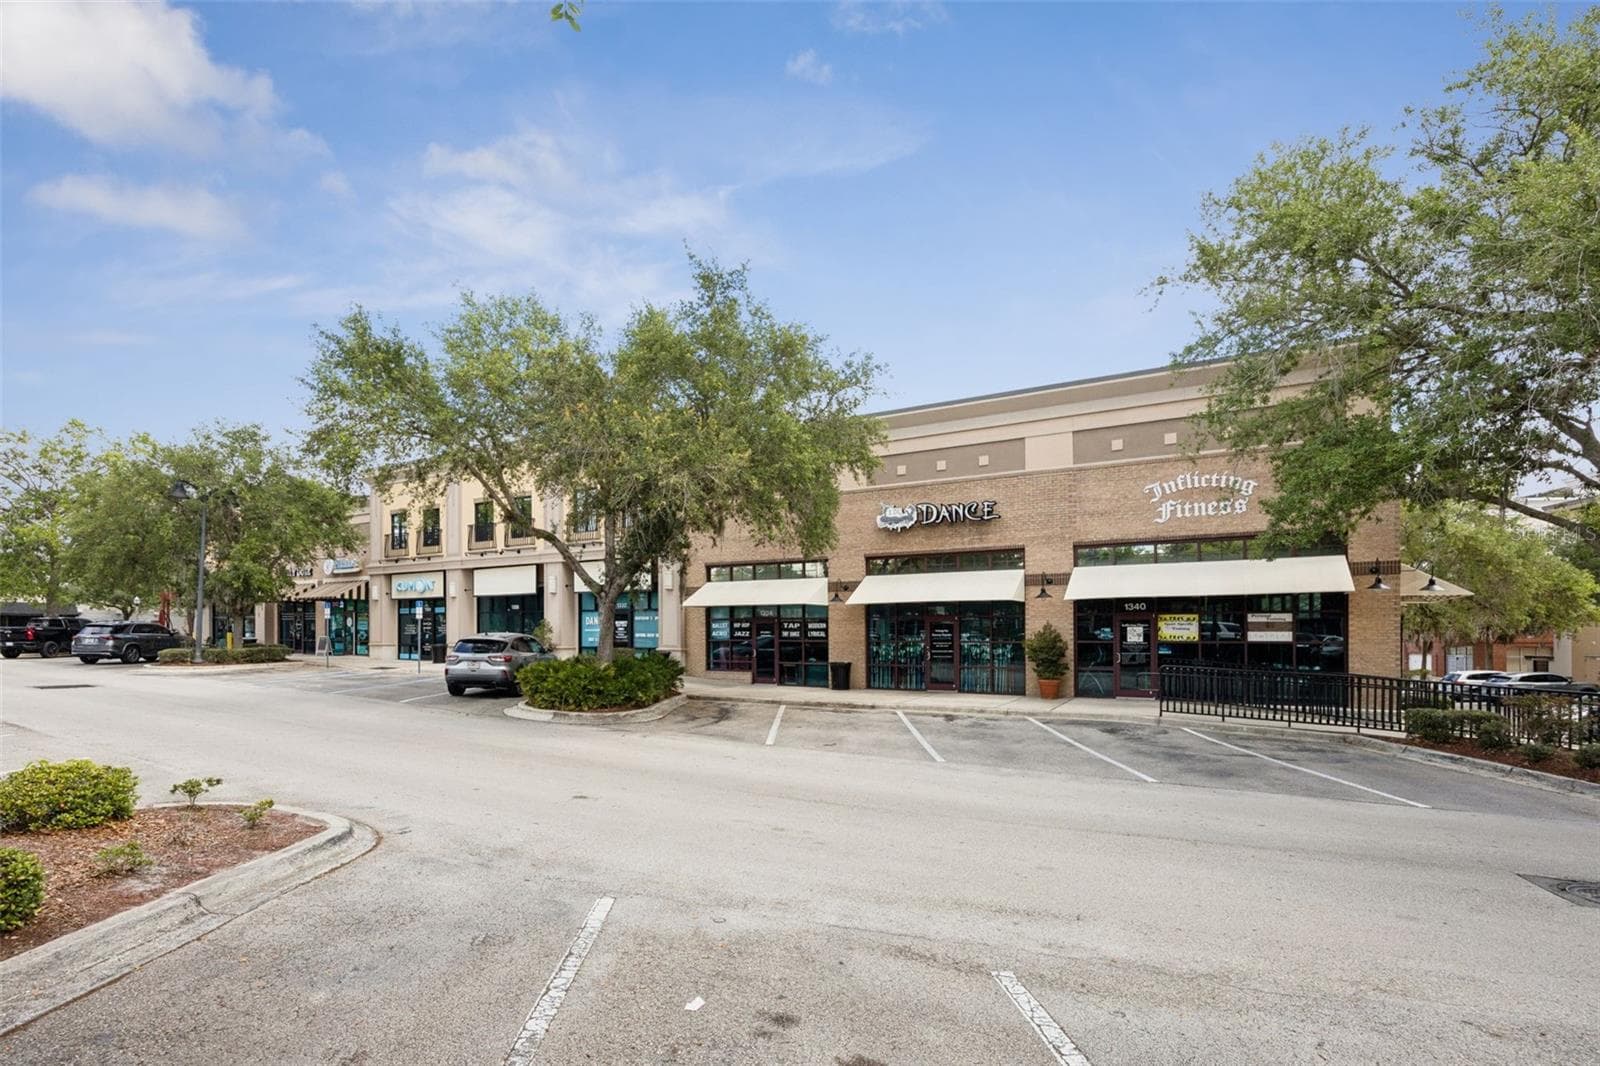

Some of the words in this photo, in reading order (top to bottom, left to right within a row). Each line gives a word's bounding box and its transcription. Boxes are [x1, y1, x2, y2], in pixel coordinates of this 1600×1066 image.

[1143, 471, 1258, 504] Inflicting
[917, 500, 1001, 525] DANCE
[1152, 497, 1249, 523] Fitness
[1124, 602, 1147, 611] 1340
